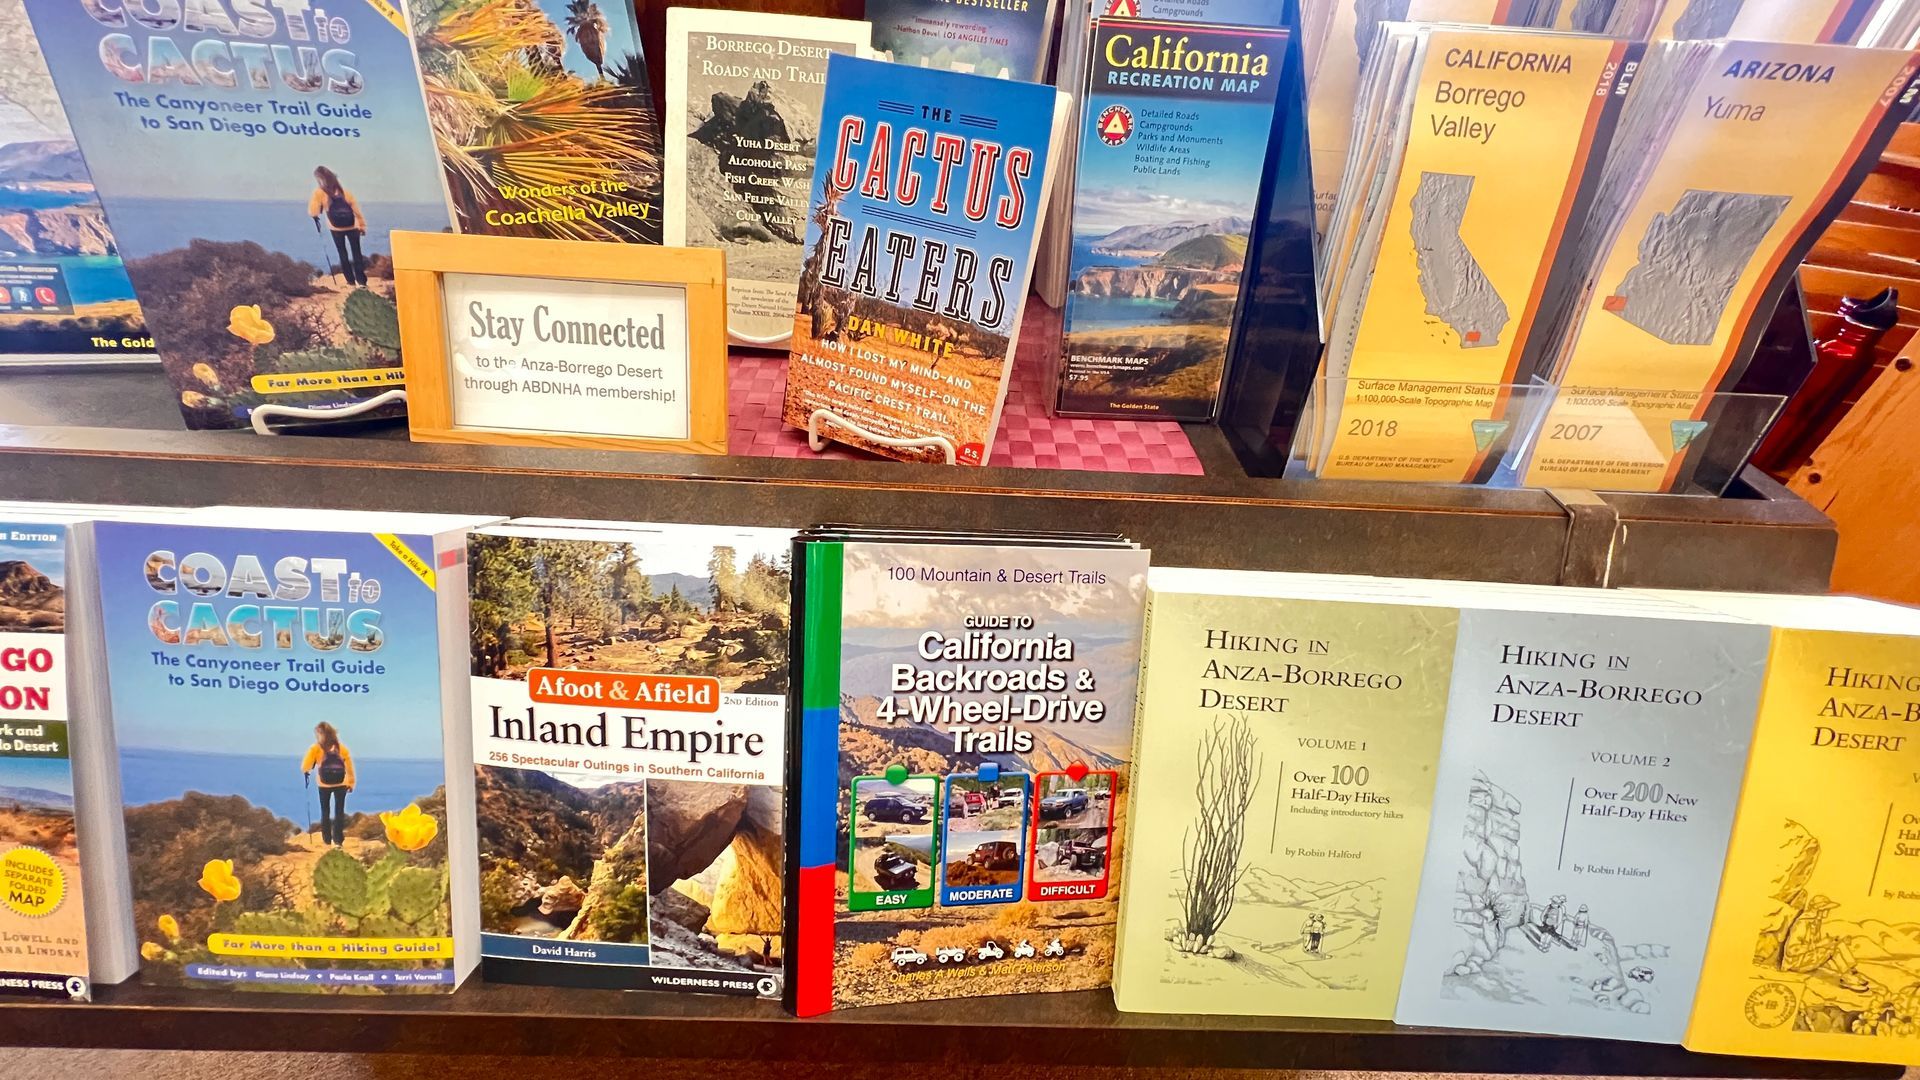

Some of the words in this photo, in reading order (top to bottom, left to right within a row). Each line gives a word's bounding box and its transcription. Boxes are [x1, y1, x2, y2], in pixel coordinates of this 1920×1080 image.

[1153, 5, 1203, 17] Campgrounds
[706, 35, 773, 54] BORREGO
[777, 40, 832, 59] DESERT
[1105, 33, 1270, 76] California
[99, 33, 364, 95] CACTUS
[1445, 47, 1574, 74] CALIFORNIA
[1722, 59, 1836, 84] ARIZONA
[1107, 71, 1214, 91] RECREATION
[1220, 78, 1260, 94] MAP
[1596, 62, 1617, 97] 2018
[1615, 61, 1638, 95] BLM
[114, 91, 150, 109] The
[156, 94, 263, 115] Canyoneer
[268, 100, 311, 118] Trail
[316, 102, 373, 120] Guide
[1434, 81, 1526, 111] Borrego
[921, 105, 953, 123] THE
[1141, 109, 1173, 119] Detailed
[1175, 112, 1200, 120] Roads
[1703, 96, 1766, 122] Yuma
[141, 115, 161, 130] to
[166, 116, 204, 131] San
[211, 117, 266, 136] Diego
[273, 121, 361, 138] Outdoors
[1140, 120, 1193, 132] Campgrounds
[1430, 114, 1496, 145] Valley
[735, 136, 762, 149] YUHA
[764, 138, 800, 152] DESERT
[728, 155, 782, 169] ALCOHOLIC
[785, 160, 807, 171] PASS
[833, 115, 1033, 229] CACTUS
[1133, 165, 1156, 174] Public
[1159, 167, 1180, 175] Lands
[498, 183, 576, 200] Wonders
[580, 181, 597, 194] of
[600, 179, 628, 192] the
[485, 205, 587, 226] Coachella
[590, 201, 650, 220] Valley
[820, 217, 1014, 329] EATERS
[468, 301, 524, 346] Stay
[533, 306, 666, 350] Connected
[848, 315, 887, 339] DAN
[893, 328, 954, 358] WHITE
[91, 337, 118, 348] The
[122, 337, 155, 348] Gold
[476, 354, 490, 369] to
[521, 357, 613, 377] Anza-Borrego
[617, 362, 664, 379] Desert
[1071, 355, 1123, 364] BENCHMARK
[1125, 357, 1149, 365] MAPS
[464, 376, 518, 393] through
[522, 379, 581, 396] ABDNHA
[586, 383, 676, 403] membership!
[1358, 381, 1396, 391] Surface
[1398, 382, 1462, 395] Management
[1464, 384, 1495, 396] Status
[828, 380, 872, 401] PACIFIC
[875, 393, 913, 413] CREST
[915, 405, 950, 425] TRAIL
[1348, 418, 1399, 437] 2018
[1551, 423, 1603, 441] 2007
[963, 447, 979, 459] P.S.
[144, 550, 348, 602] COAST
[348, 572, 381, 604] to
[887, 567, 915, 581] 100
[921, 567, 991, 583] Mountain
[996, 570, 1007, 583] &
[1013, 569, 1064, 584] Desert
[1068, 570, 1107, 585] Trails
[148, 600, 384, 653] CACTUS
[963, 615, 1009, 629] GUIDE
[1012, 616, 1034, 629] TO
[918, 631, 1074, 661] California
[1204, 629, 1298, 653] HIKING
[1309, 639, 1330, 655] IN
[1, 648, 54, 673] GO
[151, 651, 180, 666] The
[185, 654, 281, 673] Canyoneer
[286, 658, 325, 673] Trail
[331, 660, 386, 675] Guide
[1500, 644, 1595, 669] HIKING
[1606, 655, 1631, 671] IN
[168, 673, 185, 686] to
[190, 673, 222, 689] San
[228, 676, 279, 694] Diego
[284, 677, 370, 694] Outdoors
[892, 663, 1066, 692] Backroads
[1074, 669, 1095, 691] &
[1201, 659, 1402, 690] ANZA-BORREGO
[1824, 666, 1920, 692] HIKING
[0, 685, 50, 711] ON
[535, 676, 604, 700] Afoot
[608, 680, 630, 701] &
[634, 680, 711, 705] Afield
[1198, 688, 1290, 713] DESERT
[1494, 674, 1702, 706] ANZA-BORREGO
[876, 694, 1104, 723] 4-Wheel-Drive
[1490, 703, 1583, 728] DESERT
[14, 739, 59, 752] Desert
[488, 705, 608, 748] Inland
[621, 715, 765, 763] Empire
[947, 726, 1034, 753] Trails
[1811, 726, 1906, 752] DESERT
[489, 751, 509, 763] 256
[511, 753, 579, 770] Spectacular
[583, 759, 630, 774] Outings
[633, 762, 645, 773] in
[648, 763, 703, 778] Southern
[707, 766, 765, 780] California
[1293, 771, 1327, 784] Over
[1330, 764, 1370, 786] 100
[1291, 788, 1352, 805] Half-Day
[1355, 791, 1390, 805] Hikes
[1584, 787, 1618, 801] Over
[1620, 780, 1664, 804] 200
[1665, 792, 1699, 806] New
[1290, 805, 1329, 817] Including
[1330, 807, 1382, 820] introductory
[1383, 810, 1404, 819] hikes
[1581, 804, 1645, 822] Half-Day
[1649, 809, 1688, 823] Hikes
[5, 859, 54, 877] INCLUDES
[5, 870, 53, 887] SEPARATE
[1573, 863, 1584, 874] by
[1587, 864, 1615, 875] Robin
[1617, 866, 1651, 878] Halford
[9, 881, 46, 895] FOLDED
[9, 891, 45, 907] MAP
[875, 893, 908, 905] EASY
[949, 888, 1013, 902] MODERATE
[1040, 884, 1097, 896] DIFFICULT
[223, 939, 245, 950] Far
[250, 940, 285, 951] More
[291, 942, 322, 952] than
[328, 944, 336, 952] a
[342, 943, 388, 955] Hiking
[394, 943, 441, 953] Guide!
[532, 944, 562, 957] David
[565, 946, 597, 958] Harris
[651, 976, 720, 988] WILDERNESS
[723, 980, 755, 991] PRESS
[890, 970, 932, 985] Charles
[936, 969, 946, 980] A
[948, 966, 977, 979] Wells
[980, 966, 988, 976] &
[991, 963, 1016, 976] Matt
[1017, 961, 1066, 973] Peterson
